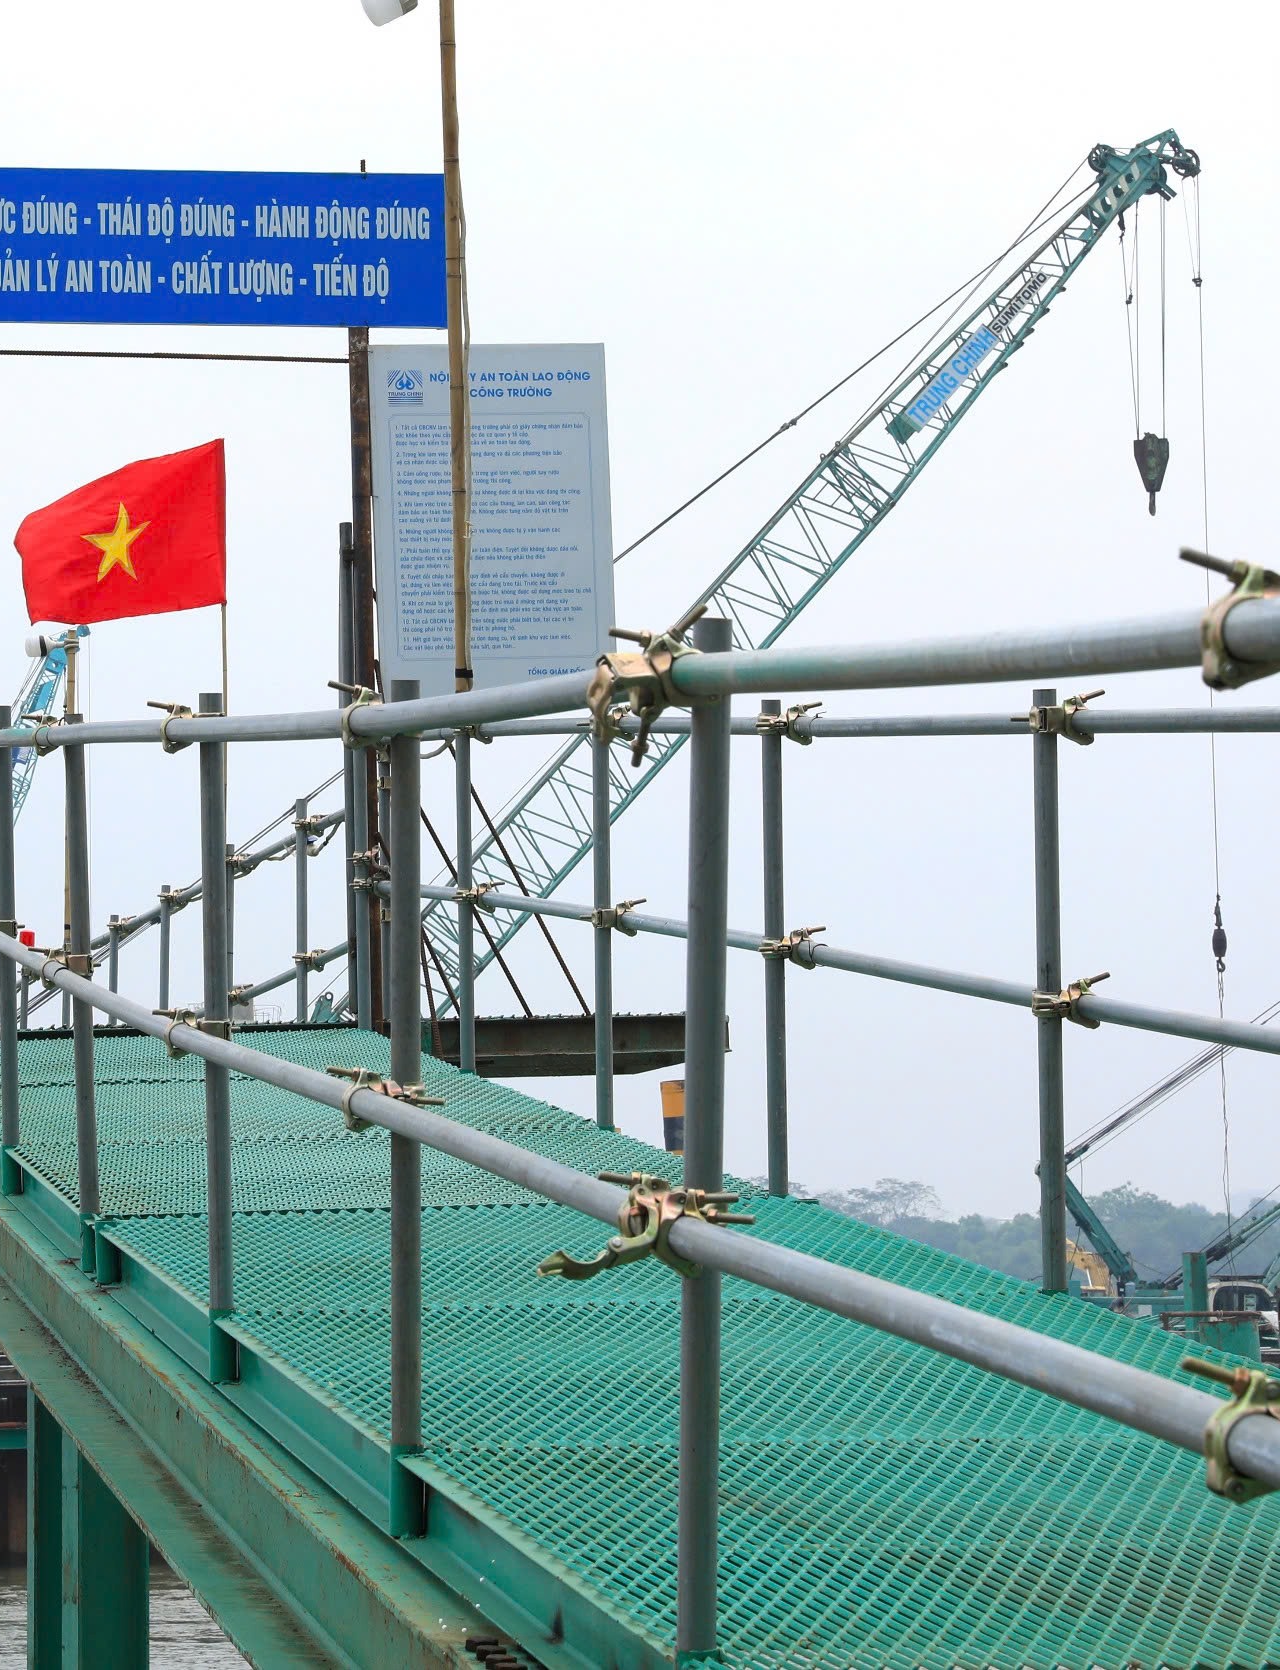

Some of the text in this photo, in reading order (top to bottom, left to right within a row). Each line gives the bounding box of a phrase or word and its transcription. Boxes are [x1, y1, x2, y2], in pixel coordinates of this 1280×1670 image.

[22, 195, 77, 234] ĐÚNG
[98, 197, 141, 235] THÁI
[148, 199, 174, 243] ĐỘ
[180, 198, 234, 237] ĐÚNG
[256, 199, 309, 237] HÀNH
[315, 200, 369, 246] ĐỘNG
[376, 200, 429, 239] ĐÚNG
[37, 253, 58, 291] LÝ
[65, 260, 92, 292] AN
[99, 254, 151, 293] TOÀN
[172, 250, 222, 294] CHẤT
[229, 260, 292, 302] LƯỢNG
[313, 254, 356, 296] TIẾN
[363, 260, 388, 304] ĐỘ
[991, 272, 1048, 334] SUMITOMO
[430, 370, 450, 384] NỘI
[480, 372, 495, 382] AN
[498, 370, 529, 382] TOÀN
[532, 372, 553, 381] LAO
[557, 370, 591, 384] ĐỘNG
[469, 385, 552, 398] CÔNG TRƯỜNG
[907, 372, 959, 424] TRUNG
[528, 666, 548, 675] TỔNG
